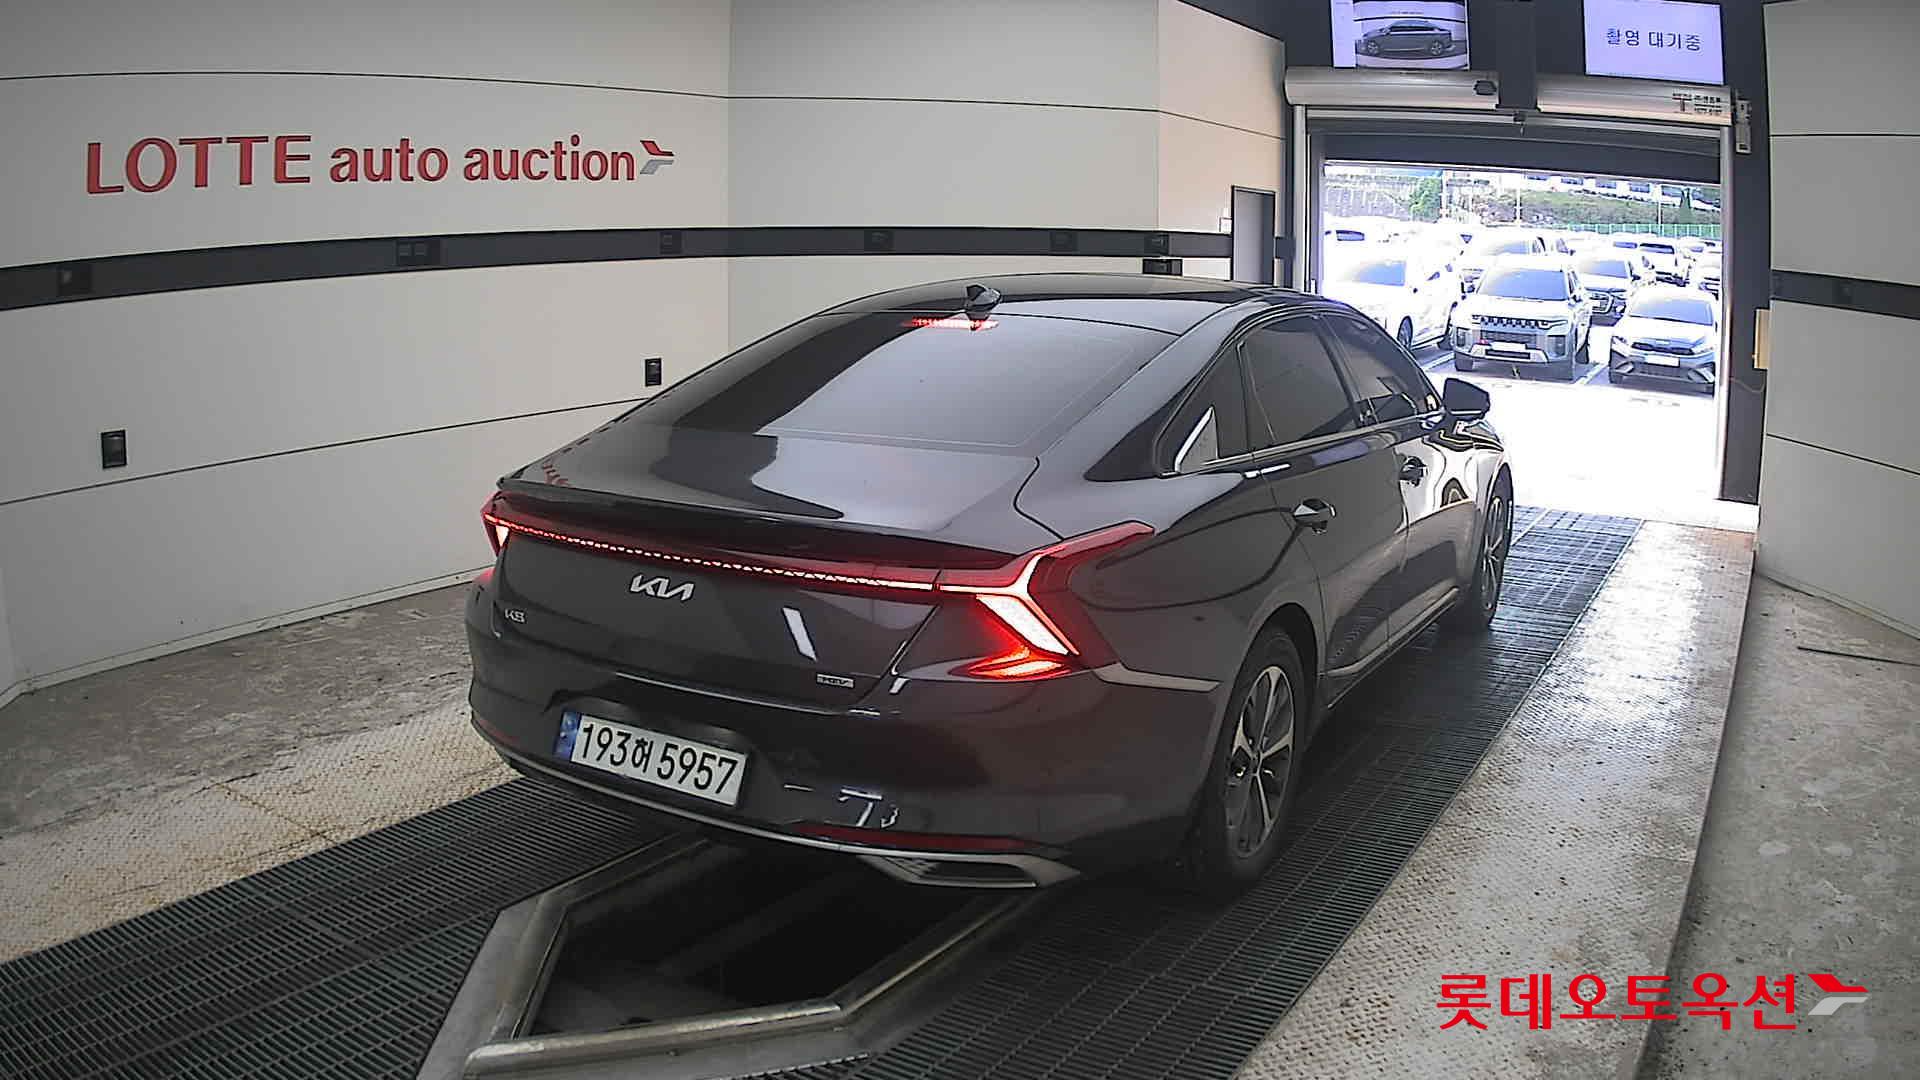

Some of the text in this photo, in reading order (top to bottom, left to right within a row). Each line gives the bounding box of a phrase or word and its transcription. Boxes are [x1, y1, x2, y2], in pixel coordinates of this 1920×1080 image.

[1648, 31, 1701, 51] 대기중
[87, 134, 636, 195] LOTTE auto auction
[656, 742, 739, 795] 5957
